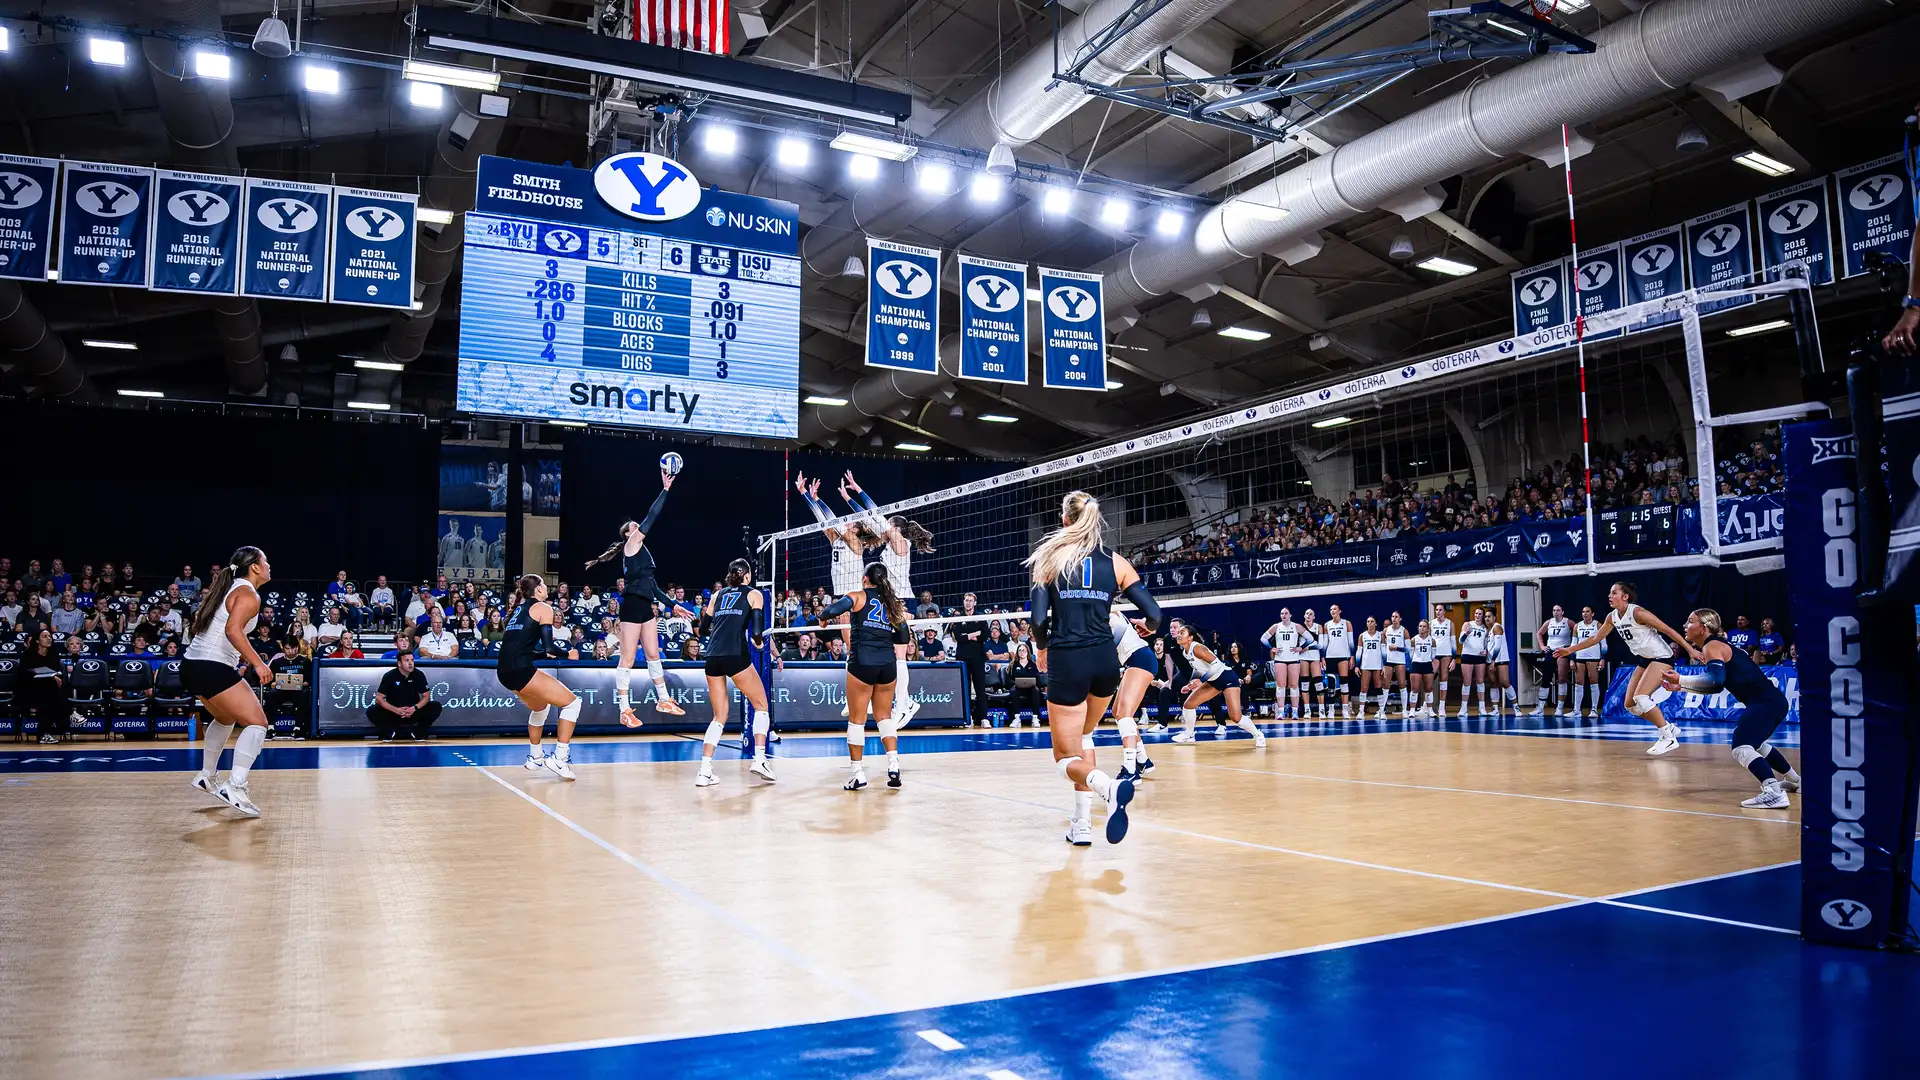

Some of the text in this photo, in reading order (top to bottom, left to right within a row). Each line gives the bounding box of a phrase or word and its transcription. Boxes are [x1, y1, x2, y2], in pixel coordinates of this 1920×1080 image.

[513, 174, 561, 190] SMITH
[610, 156, 688, 216] Y
[488, 186, 583, 210] FIELDHOUSE
[0, 217, 21, 228] 003
[728, 212, 790, 236] NU SKIN
[1867, 214, 1890, 228] 2014
[92, 225, 119, 235] 2013
[500, 222, 533, 240] BYU
[1867, 224, 1893, 238] MPSF
[78, 236, 132, 248] NATIONAL
[183, 234, 210, 244] 2016
[633, 238, 650, 248] SET
[1784, 238, 1806, 250] 2016
[1852, 229, 1910, 251] CHAMPIONS
[74, 246, 136, 258] RUNNER-UP
[171, 244, 221, 256] NATIONAL
[273, 242, 298, 251] 2017
[597, 238, 610, 256] 5
[260, 250, 310, 263] NATIONAL
[361, 249, 386, 259] 2021
[637, 251, 642, 264] 1
[670, 248, 682, 266] 6
[1784, 247, 1808, 260] MPSF
[166, 254, 225, 266] RUNNER-UP
[350, 258, 397, 270] NATIONAL
[698, 254, 731, 268] STATE
[742, 254, 771, 271] USU
[1711, 260, 1730, 272] 2017
[256, 261, 313, 274] RUNNER-UP
[346, 268, 400, 280] RUNNER-UP
[545, 260, 730, 299] 3 KILLS 3
[760, 272, 764, 280] 2
[1711, 270, 1732, 282] MPSF
[1644, 281, 1663, 290] 2018
[1644, 288, 1665, 299] MPSF
[526, 280, 744, 322] .286 HIT % .091
[1585, 296, 1602, 306] 2021
[880, 304, 926, 320] NATIONAL
[1530, 308, 1550, 318] FINAL
[1585, 303, 1604, 312] MPSF
[534, 302, 737, 340] 1.0 BLOCKS 1.0
[875, 314, 931, 331] CHAMPIONS
[972, 318, 1014, 332] NATIONAL
[1532, 316, 1548, 325] FOUR
[542, 322, 726, 359] 0 ACES 1
[967, 328, 1020, 342] CHAMPIONS
[1054, 329, 1094, 340] NATIONAL
[1049, 338, 1098, 351] CHAMPIONS
[540, 343, 728, 380] 4 DIGS 3
[890, 350, 914, 361] 1999
[982, 362, 1004, 373] 2001
[1344, 374, 1387, 394] dōTERRA
[1432, 350, 1480, 372] dōTERRA
[1064, 370, 1086, 380] 2004
[570, 381, 700, 424] smarty
[1602, 512, 1618, 520] HOME
[1631, 509, 1650, 522] 1:15
[1653, 506, 1672, 514] GUEST
[1822, 488, 1858, 588] GO
[1473, 542, 1494, 554] TCU
[832, 550, 839, 562] 9
[1284, 562, 1297, 570] BIG
[1310, 554, 1371, 567] CONFERENCE
[437, 568, 504, 579] EYBAL
[1080, 557, 1092, 588] 1
[1060, 589, 1110, 600] COUGARS
[720, 592, 742, 610] 17
[508, 606, 522, 625] 2
[1331, 630, 1342, 638] 42
[1434, 628, 1445, 636] 44
[1473, 630, 1482, 638] 14
[1552, 628, 1561, 636] 17
[1731, 634, 1748, 642] BYU
[430, 682, 515, 709] Couture
[114, 720, 146, 728] dōTERRA
[158, 720, 188, 728] dōTERRA
[1828, 616, 1864, 872] COUGS
